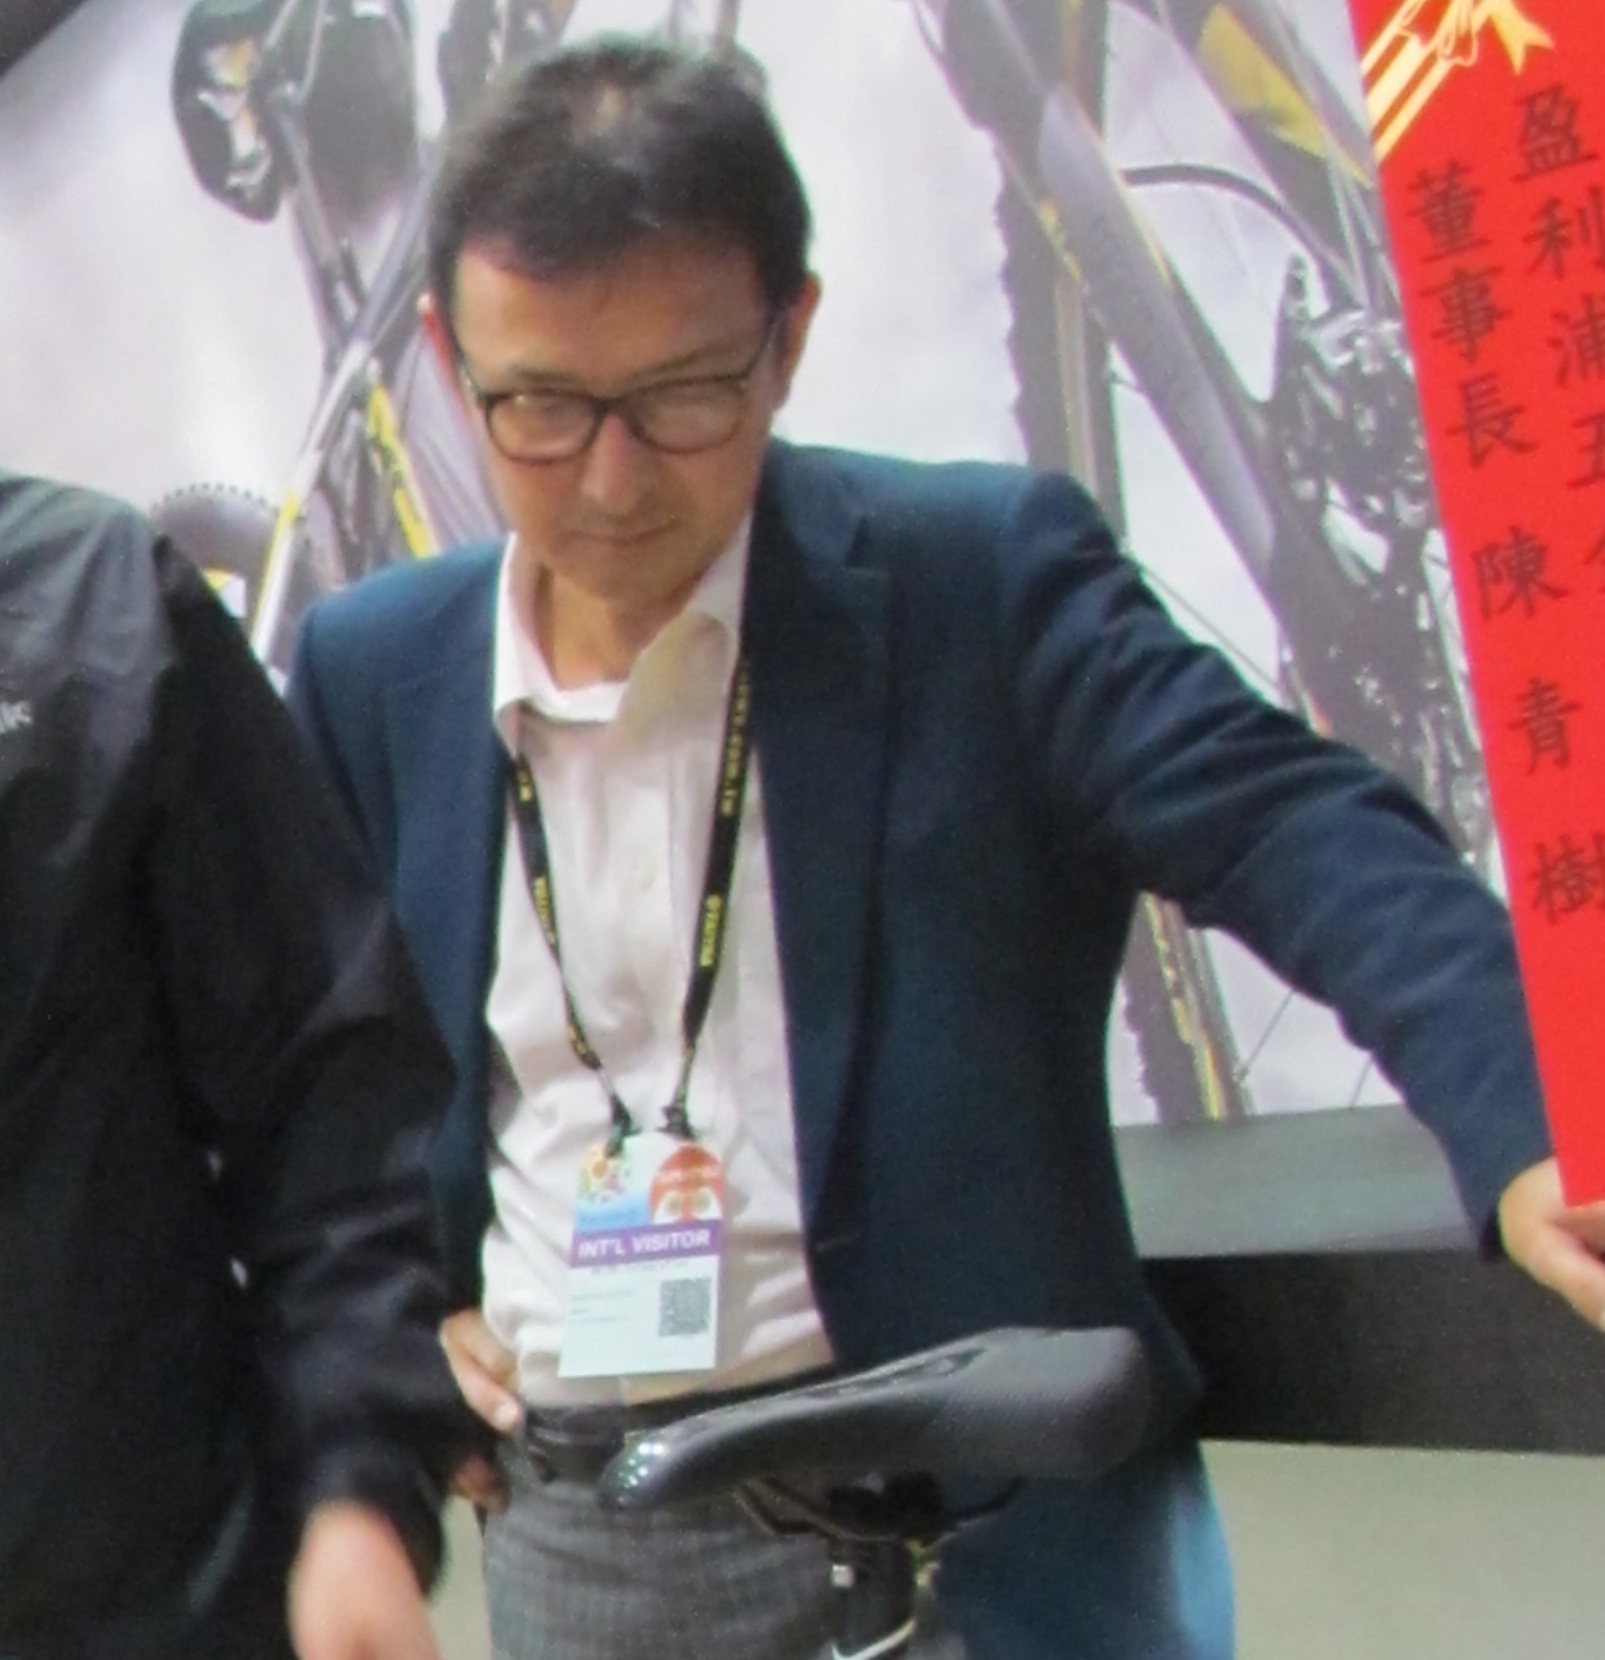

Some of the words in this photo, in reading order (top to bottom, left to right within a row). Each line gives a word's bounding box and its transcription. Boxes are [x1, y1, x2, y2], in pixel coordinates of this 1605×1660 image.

[1406, 159, 1538, 470] 董事長
[578, 1236, 625, 1258] INT'L
[632, 1229, 711, 1253] VISITOR
